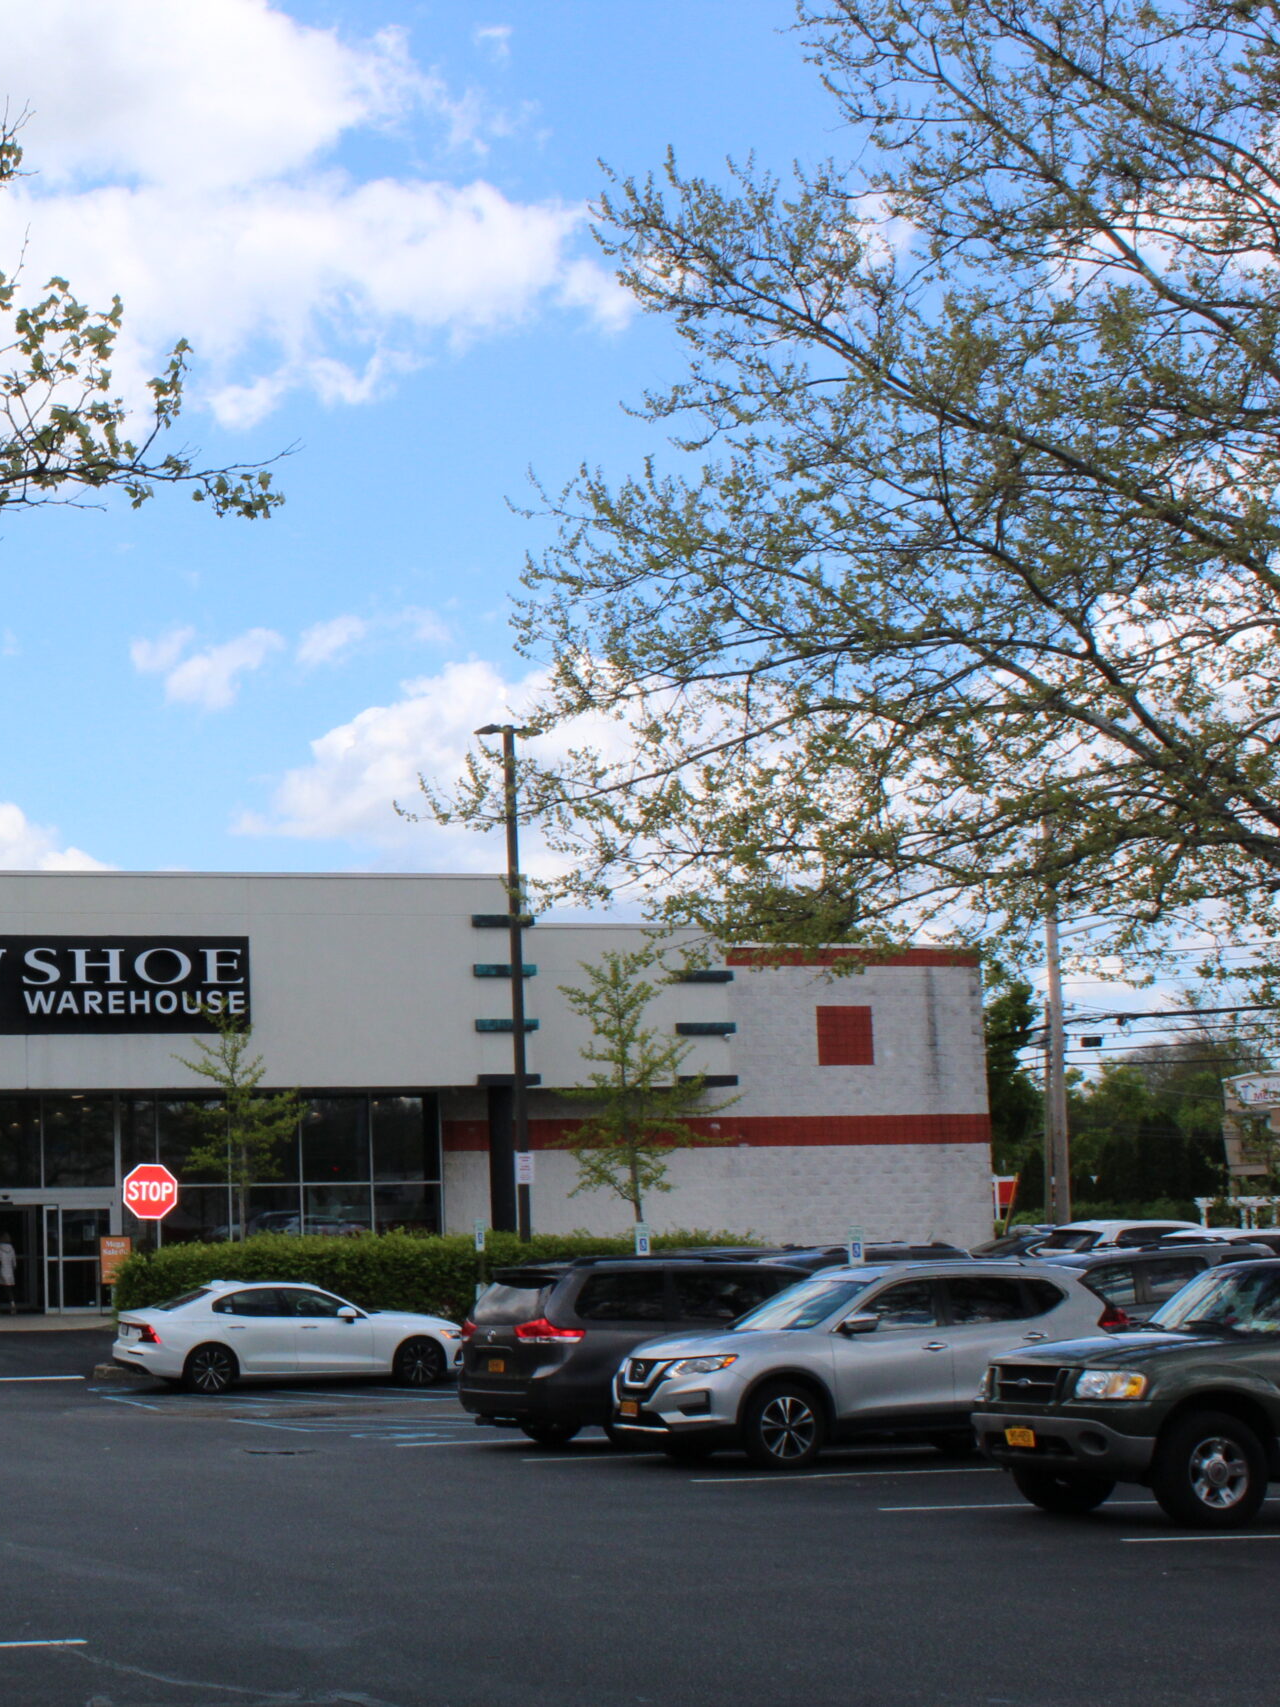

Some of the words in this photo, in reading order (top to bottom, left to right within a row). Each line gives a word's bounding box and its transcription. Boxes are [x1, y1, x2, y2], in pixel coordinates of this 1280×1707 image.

[22, 947, 245, 985] SHOE
[23, 989, 246, 1015] WAREHOUSE
[127, 1181, 174, 1202] STOP
